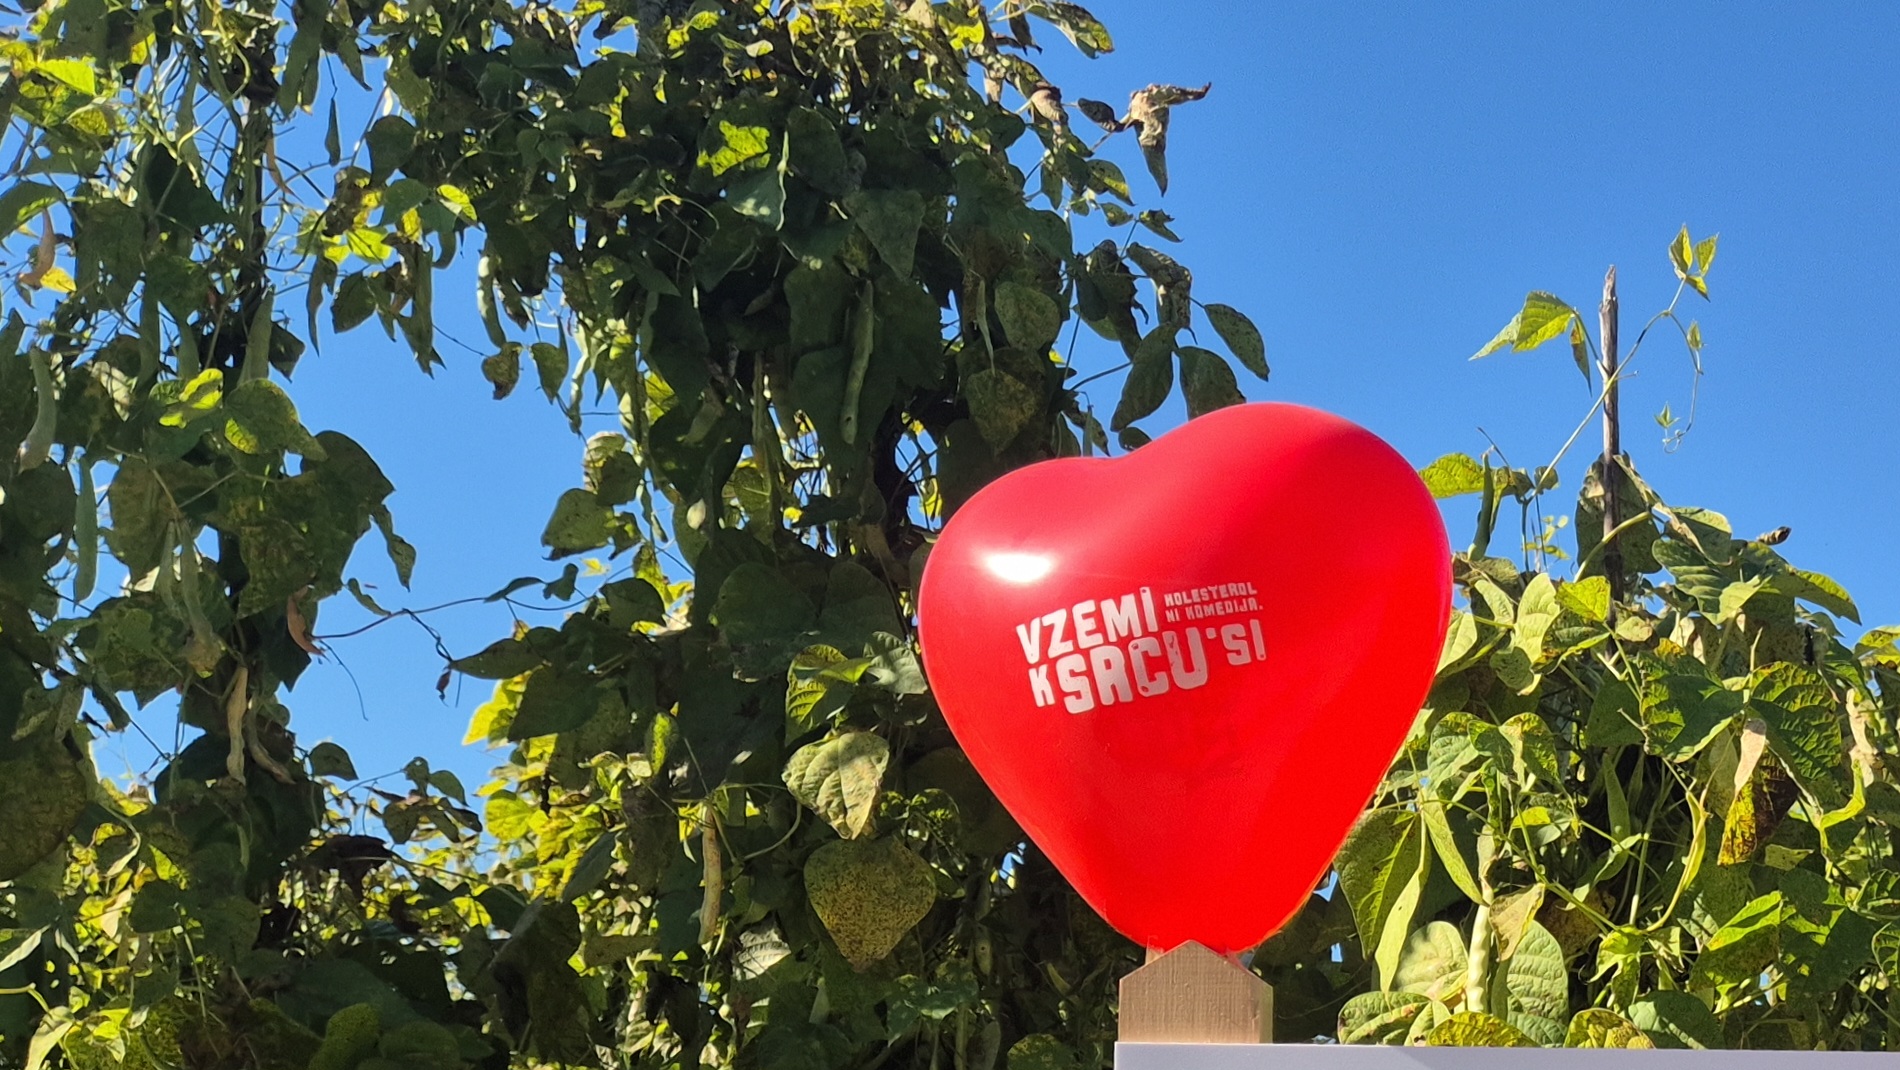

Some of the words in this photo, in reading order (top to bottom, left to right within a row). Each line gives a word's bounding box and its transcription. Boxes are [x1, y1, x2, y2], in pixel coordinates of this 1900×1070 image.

[1016, 586, 1159, 664] VZEMI
[1165, 608, 1180, 622] NI
[1028, 664, 1055, 707] K
